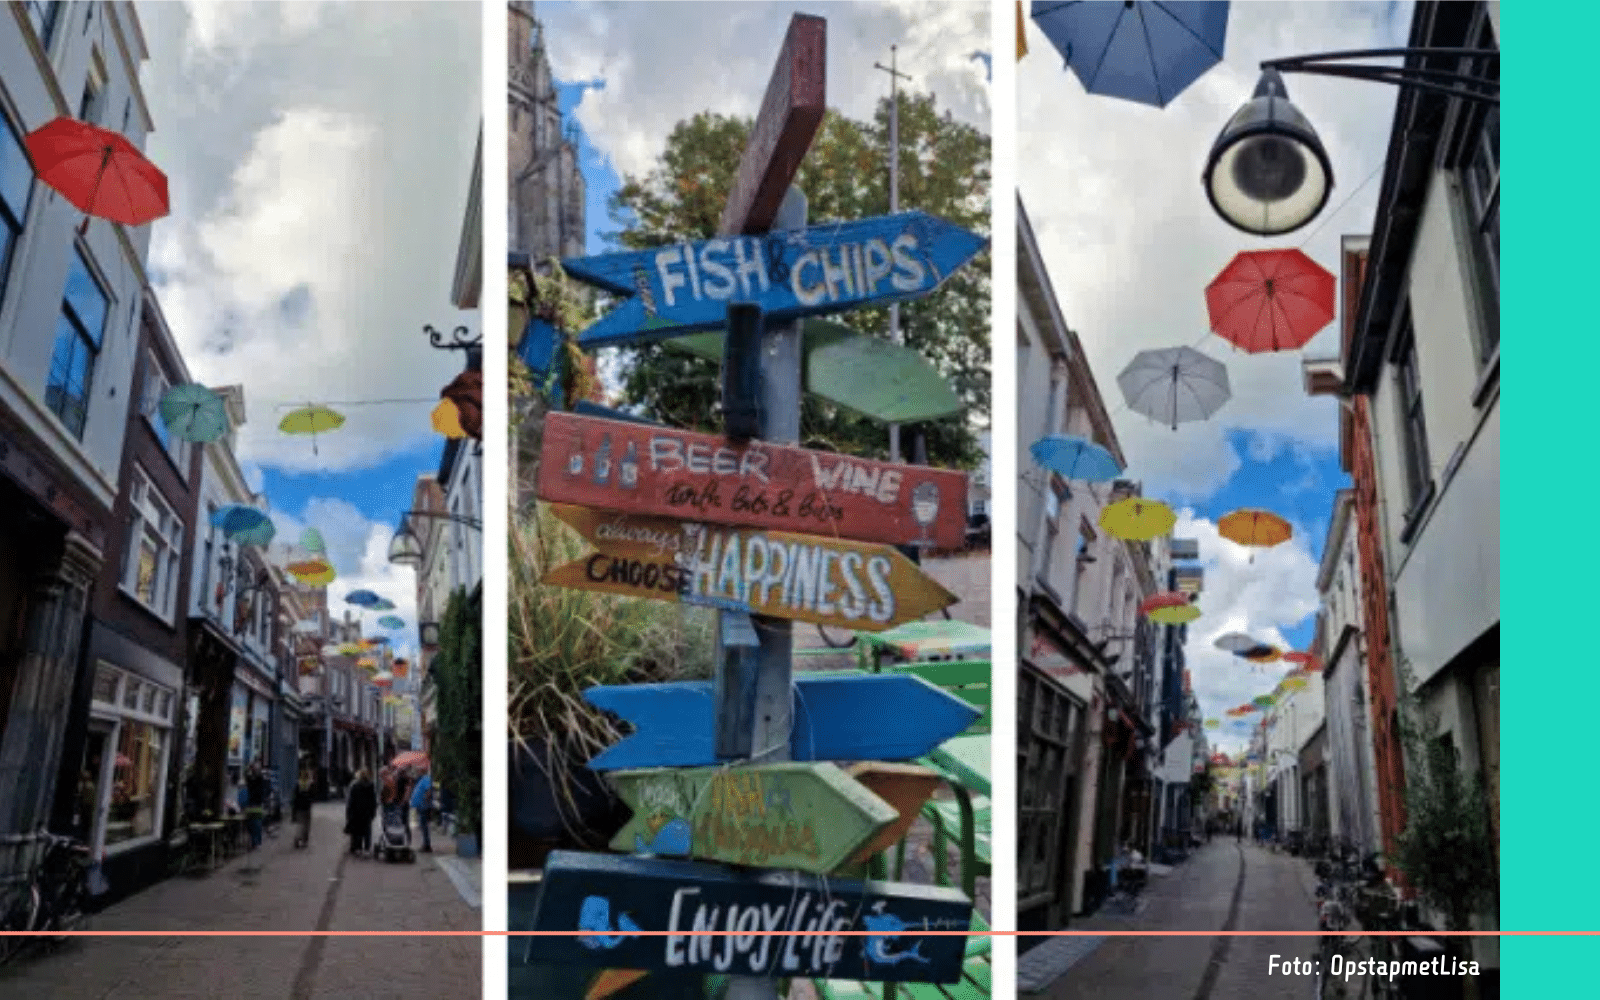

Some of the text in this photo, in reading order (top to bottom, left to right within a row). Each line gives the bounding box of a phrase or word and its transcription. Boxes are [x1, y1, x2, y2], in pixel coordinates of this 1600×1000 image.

[655, 238, 771, 306] FISH
[768, 239, 791, 289] &
[790, 232, 926, 306] CHIPS
[650, 437, 905, 503] BEER WINE
[586, 525, 896, 623] CHOOSE HAPPINESS
[595, 516, 680, 558] always
[665, 886, 787, 972] ENJOY
